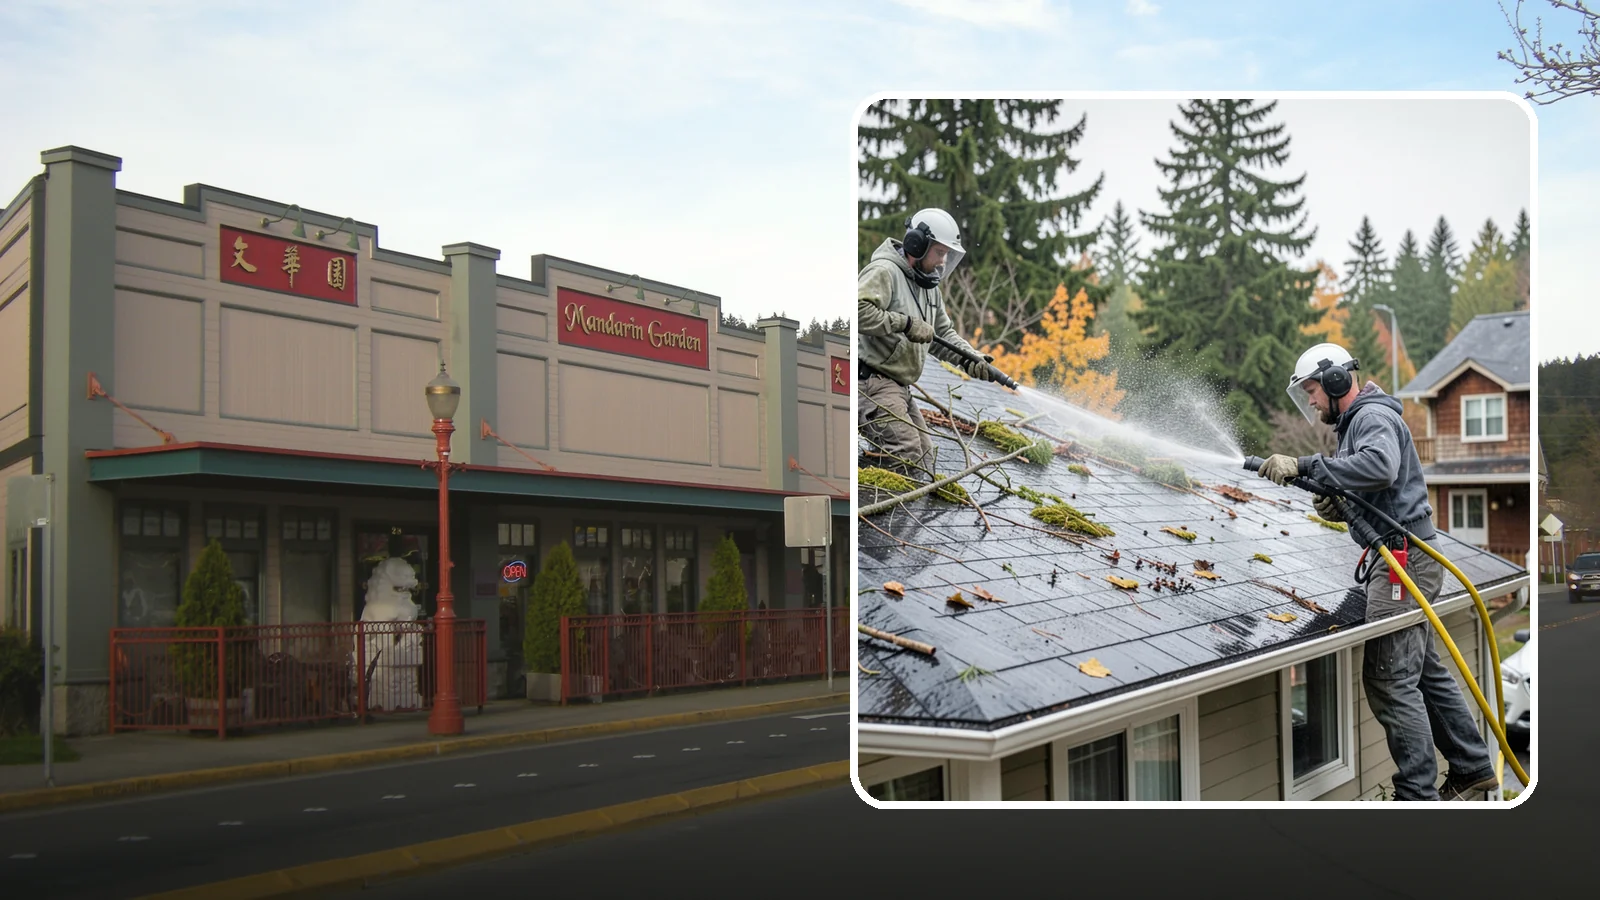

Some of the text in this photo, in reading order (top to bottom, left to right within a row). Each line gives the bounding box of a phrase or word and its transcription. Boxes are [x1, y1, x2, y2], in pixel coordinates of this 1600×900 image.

[564, 302, 701, 352] Mandarin Garden
[503, 565, 527, 578] OPEN
